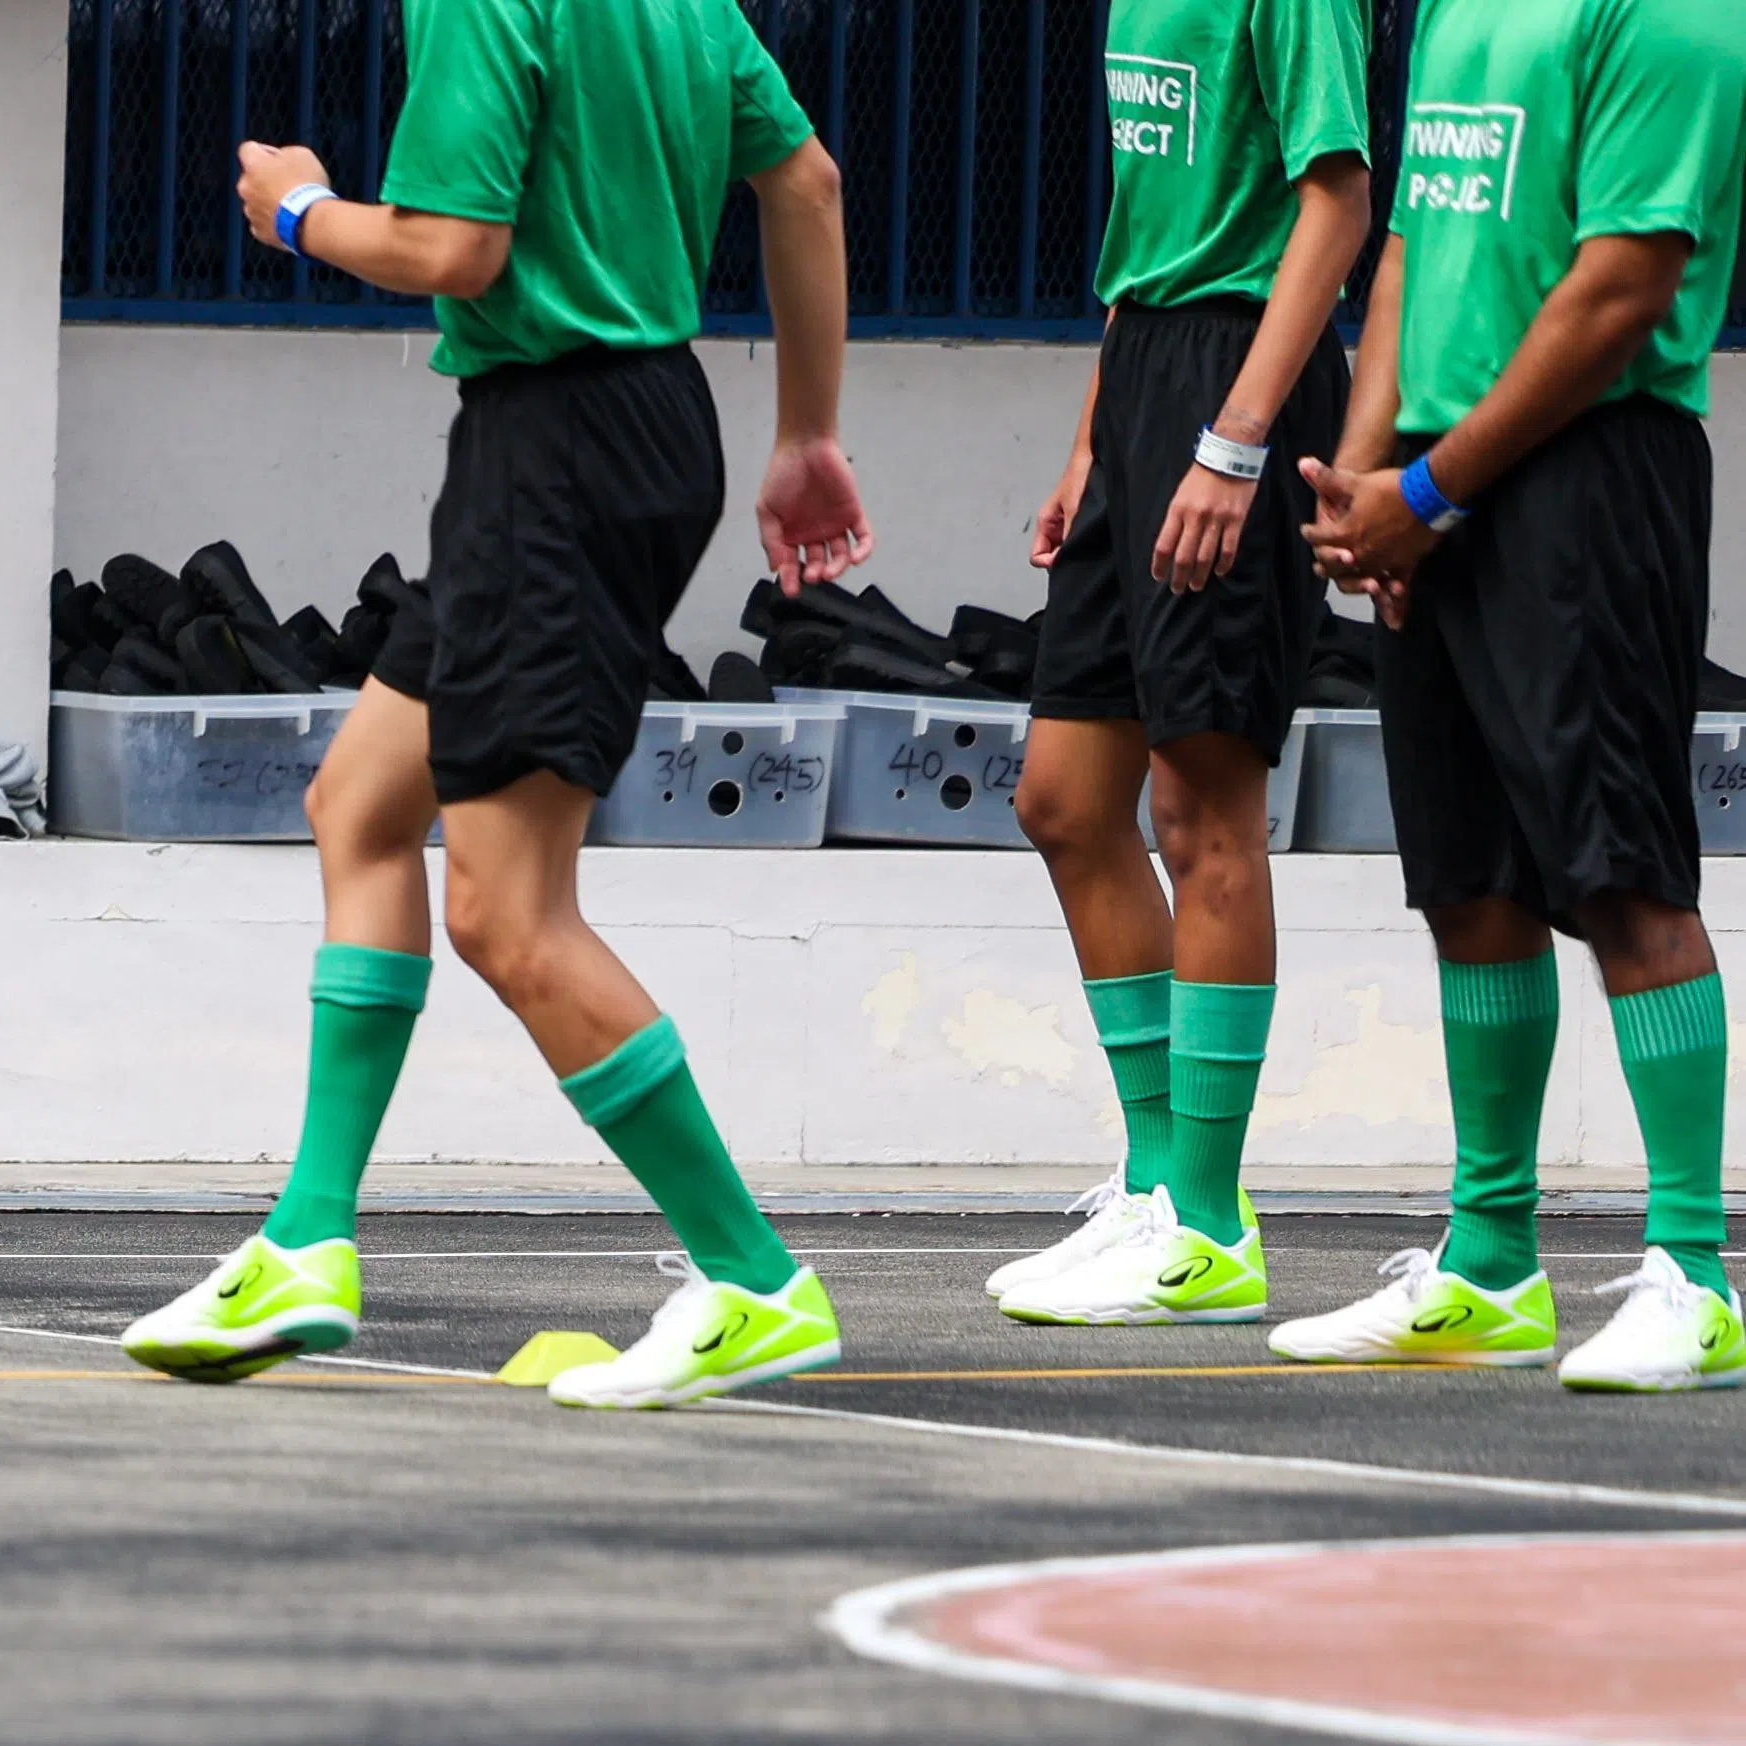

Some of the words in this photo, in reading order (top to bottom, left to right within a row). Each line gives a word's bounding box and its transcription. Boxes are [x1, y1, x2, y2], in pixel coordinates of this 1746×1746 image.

[655, 745, 698, 793] 39
[747, 751, 826, 794] (245)
[888, 743, 943, 787] 40
